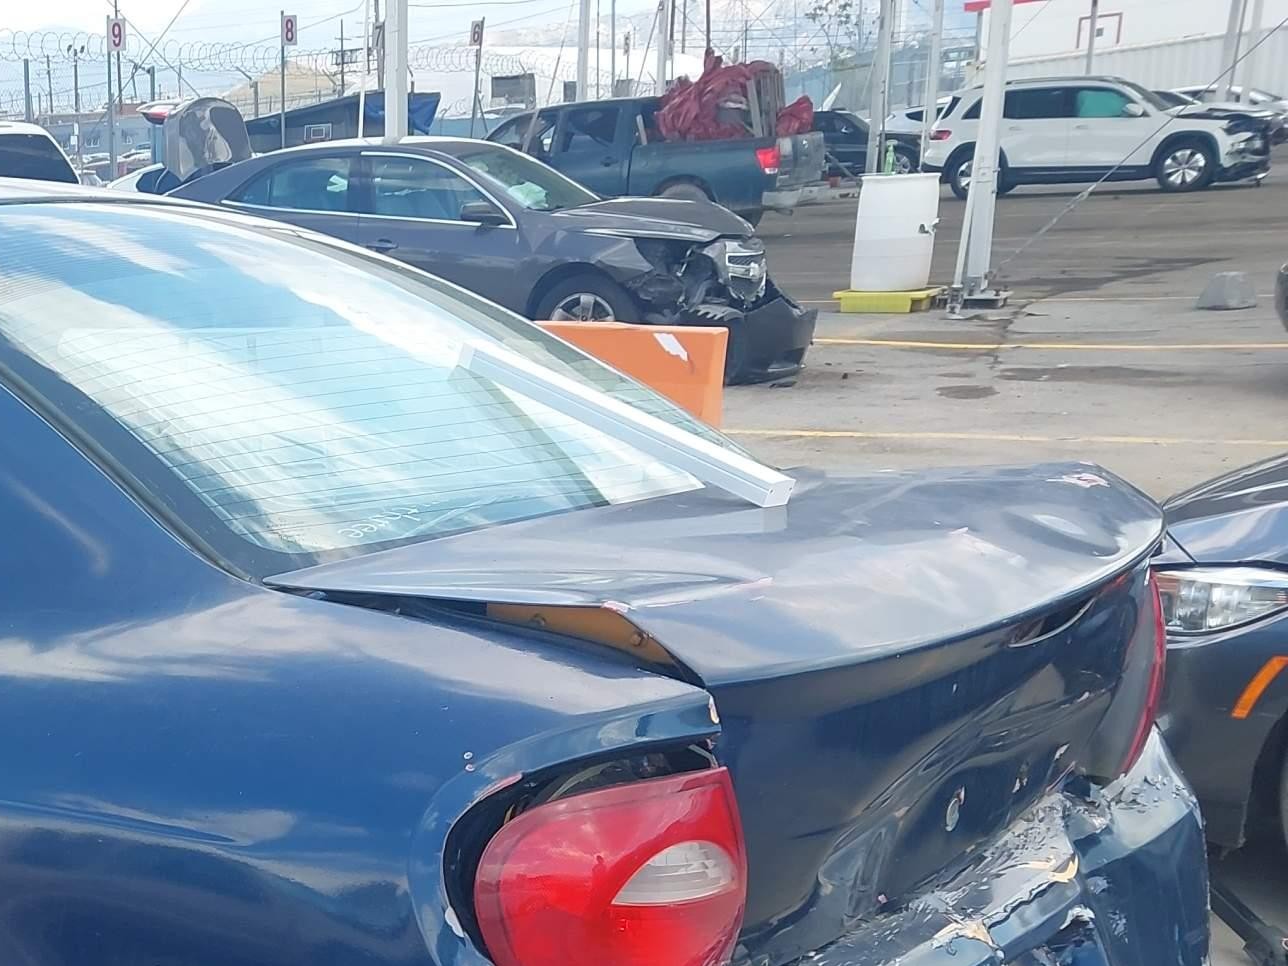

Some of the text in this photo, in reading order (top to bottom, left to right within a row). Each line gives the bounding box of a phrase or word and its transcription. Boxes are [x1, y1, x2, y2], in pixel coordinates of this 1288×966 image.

[112, 22, 122, 47] 9
[285, 18, 294, 42] 8
[375, 25, 383, 47] 7
[472, 23, 481, 43] 6
